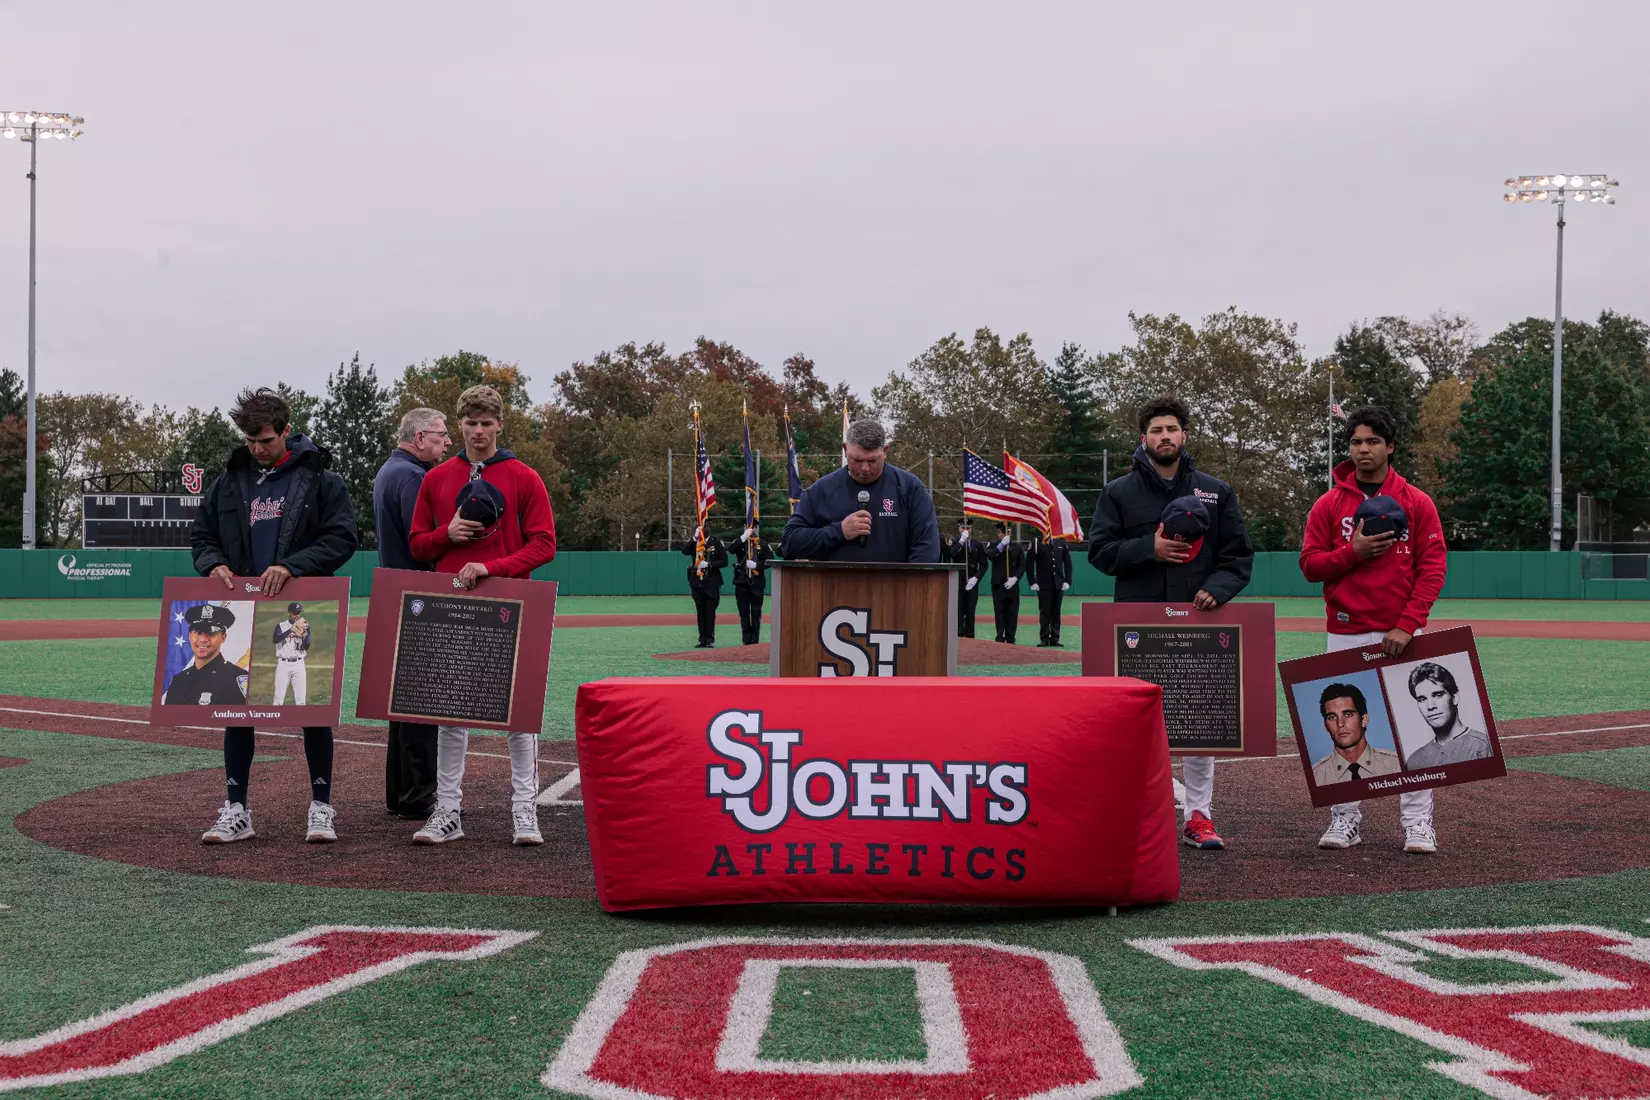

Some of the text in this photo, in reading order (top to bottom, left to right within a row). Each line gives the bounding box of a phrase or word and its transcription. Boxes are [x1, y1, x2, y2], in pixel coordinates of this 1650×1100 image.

[96, 497, 102, 506] AT
[105, 497, 116, 506] BAT
[140, 498, 153, 506] BALL
[212, 710, 247, 719] Anthony
[1368, 772, 1447, 790] Michael Weinburg
[706, 842, 1027, 880] ATHLETICS
